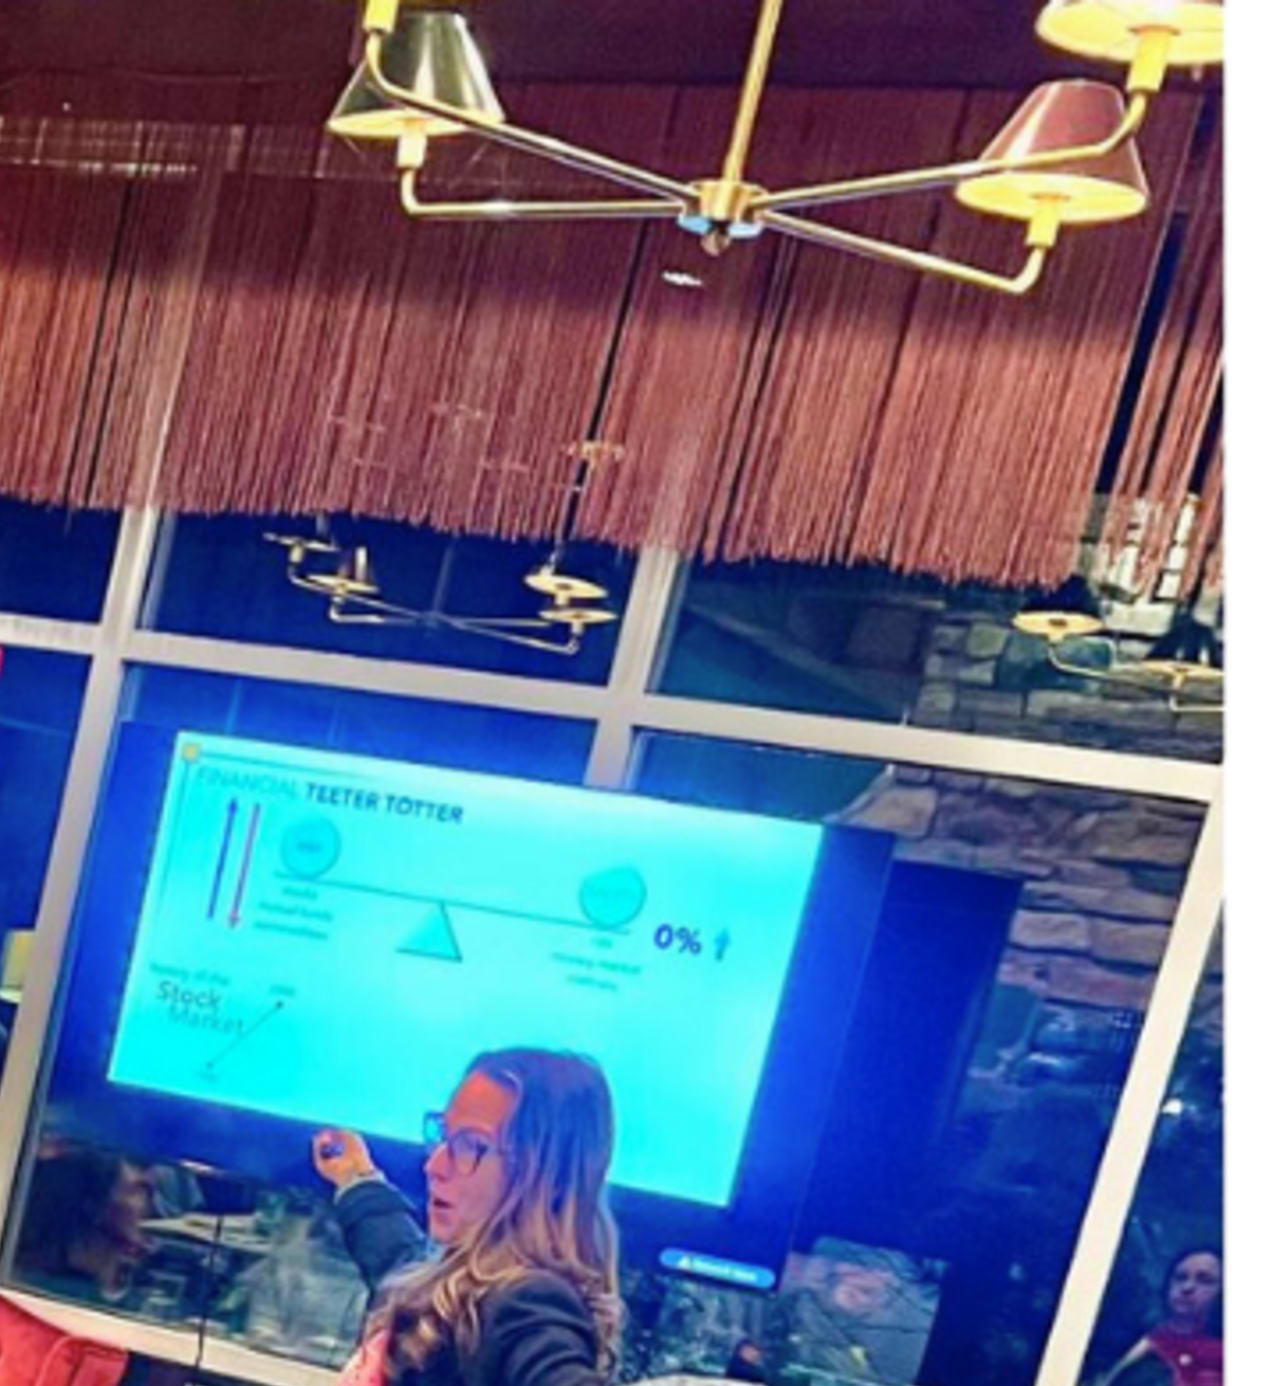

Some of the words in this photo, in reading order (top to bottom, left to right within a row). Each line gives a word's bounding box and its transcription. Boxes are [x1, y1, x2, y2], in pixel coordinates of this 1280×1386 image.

[305, 781, 379, 812] TEETER
[385, 794, 465, 825] TOTTER
[653, 922, 703, 955] 0%
[155, 979, 221, 1008] Stock
